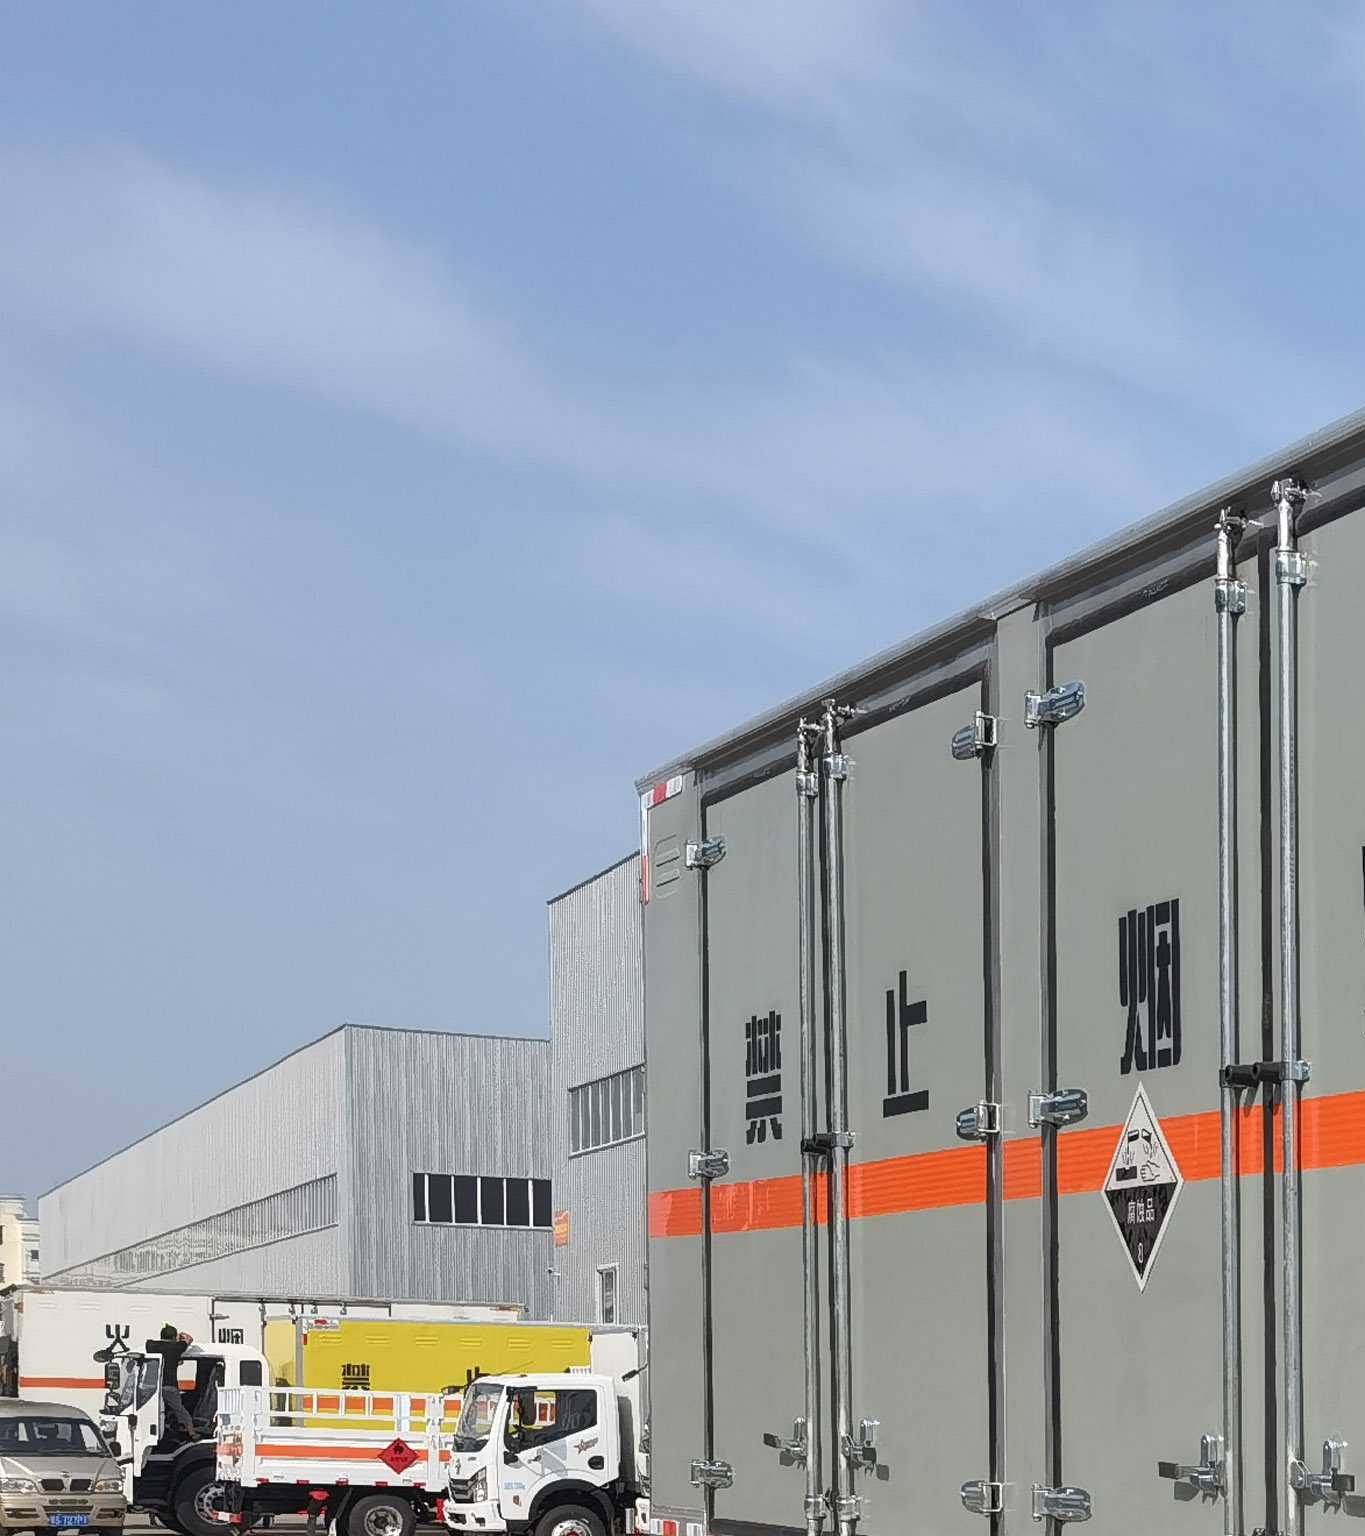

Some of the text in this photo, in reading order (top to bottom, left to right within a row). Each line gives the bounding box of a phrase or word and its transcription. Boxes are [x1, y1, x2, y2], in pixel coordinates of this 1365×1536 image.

[745, 1009, 782, 1144] 禁
[883, 970, 929, 1118] 止
[1118, 898, 1181, 1075] 烟
[105, 1324, 131, 1351] 火
